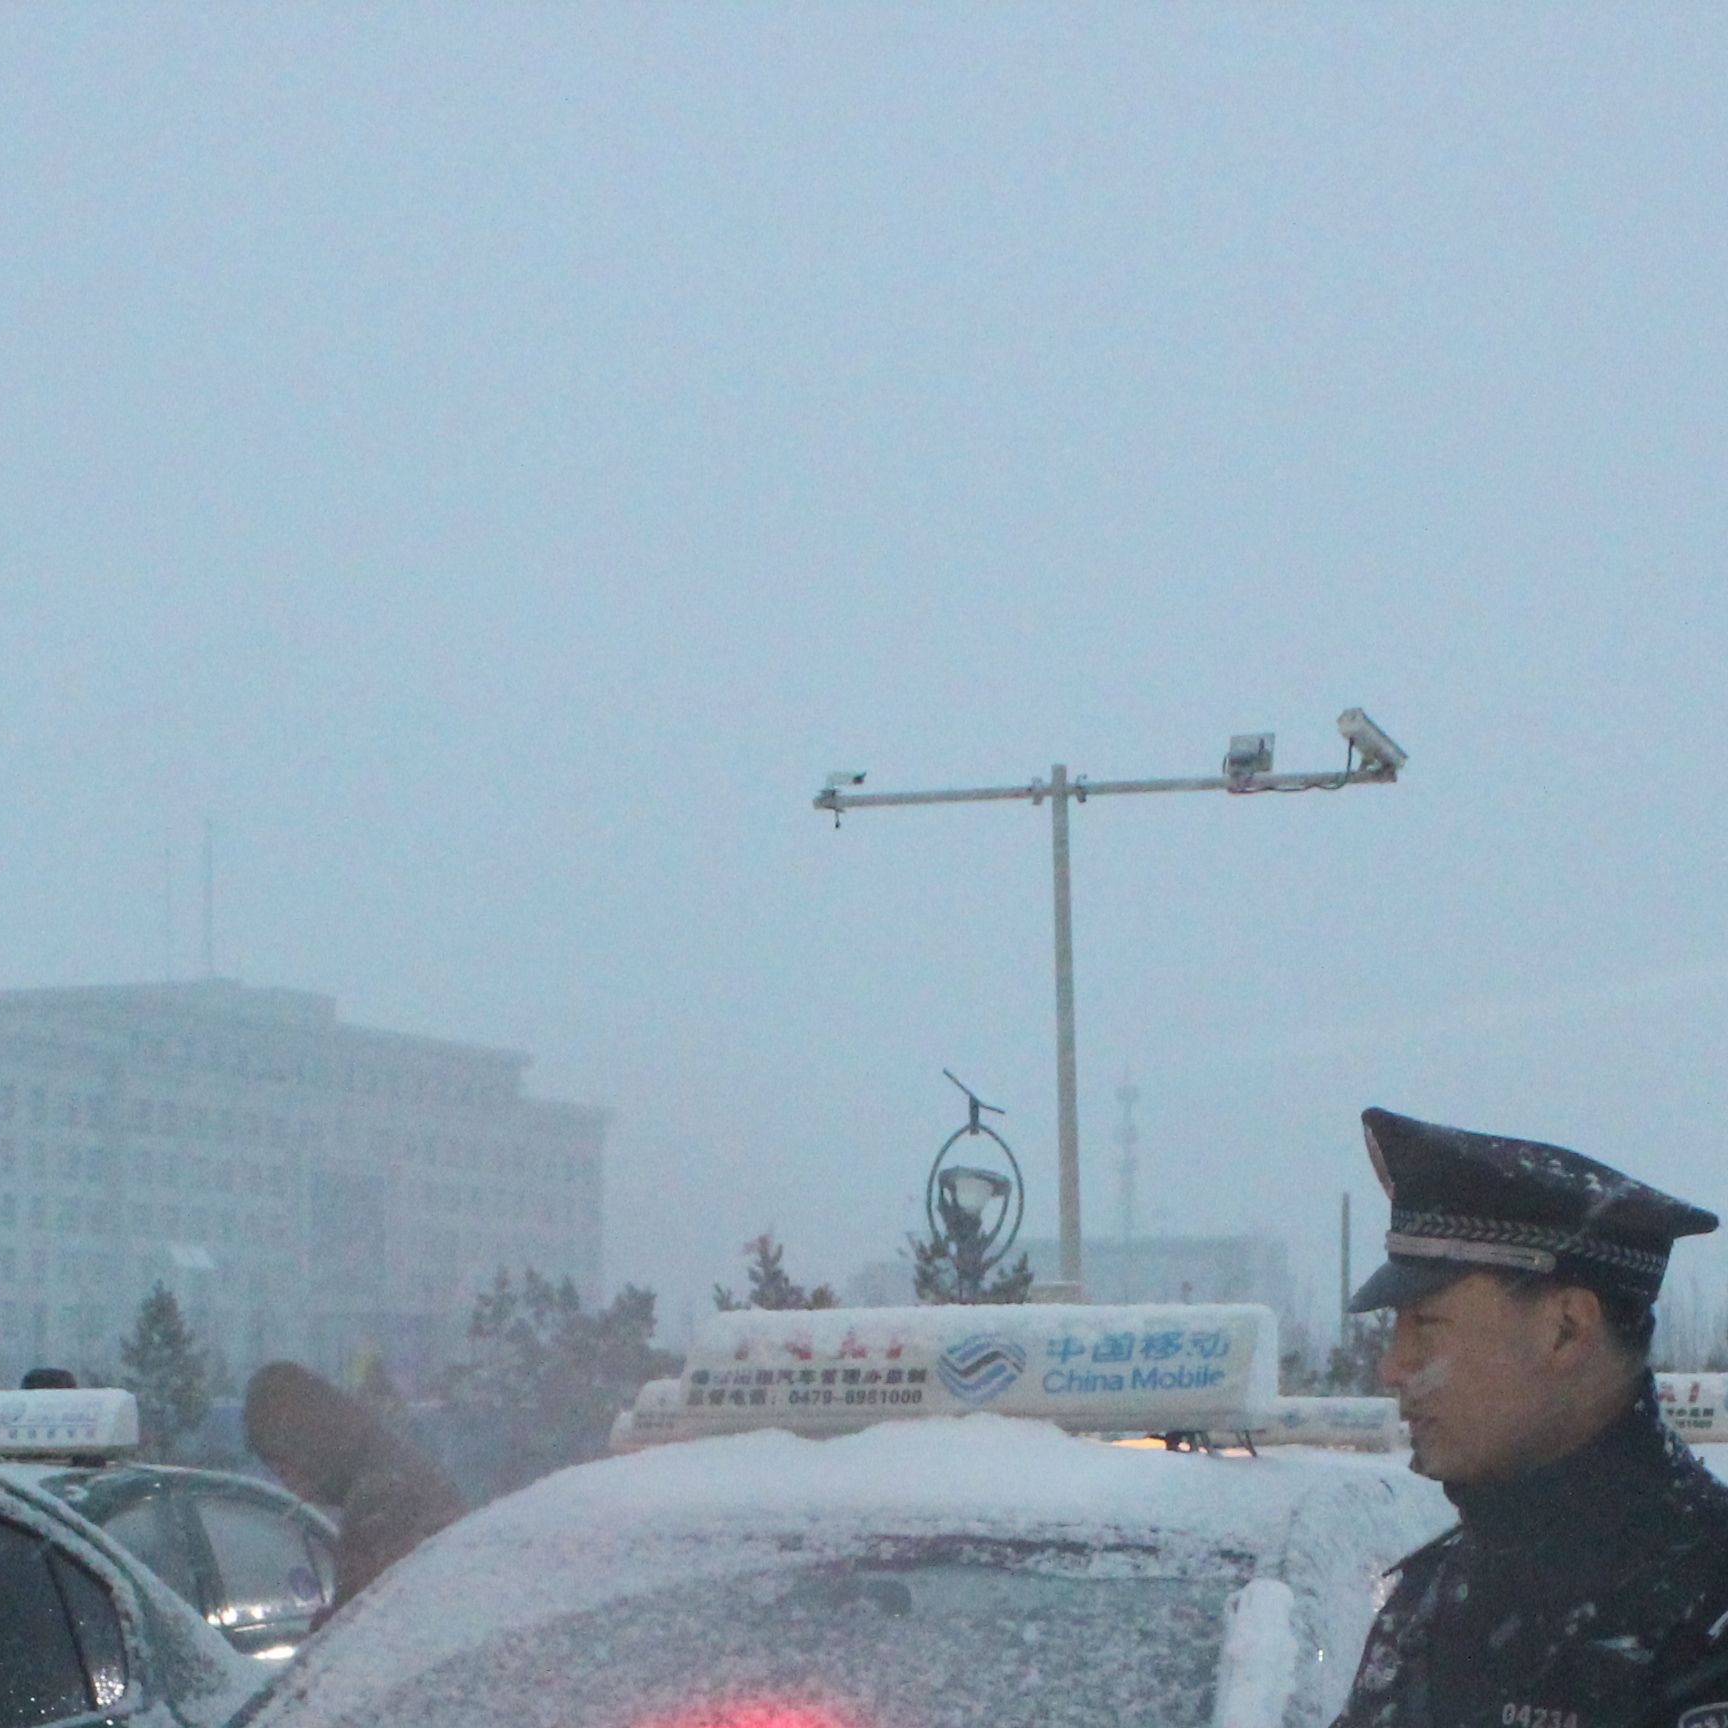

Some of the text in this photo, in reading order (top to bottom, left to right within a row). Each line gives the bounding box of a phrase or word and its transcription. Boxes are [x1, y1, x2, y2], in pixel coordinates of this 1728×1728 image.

[1046, 1329, 1231, 1363] 中国移动
[1042, 1365, 1225, 1393] China Mobile
